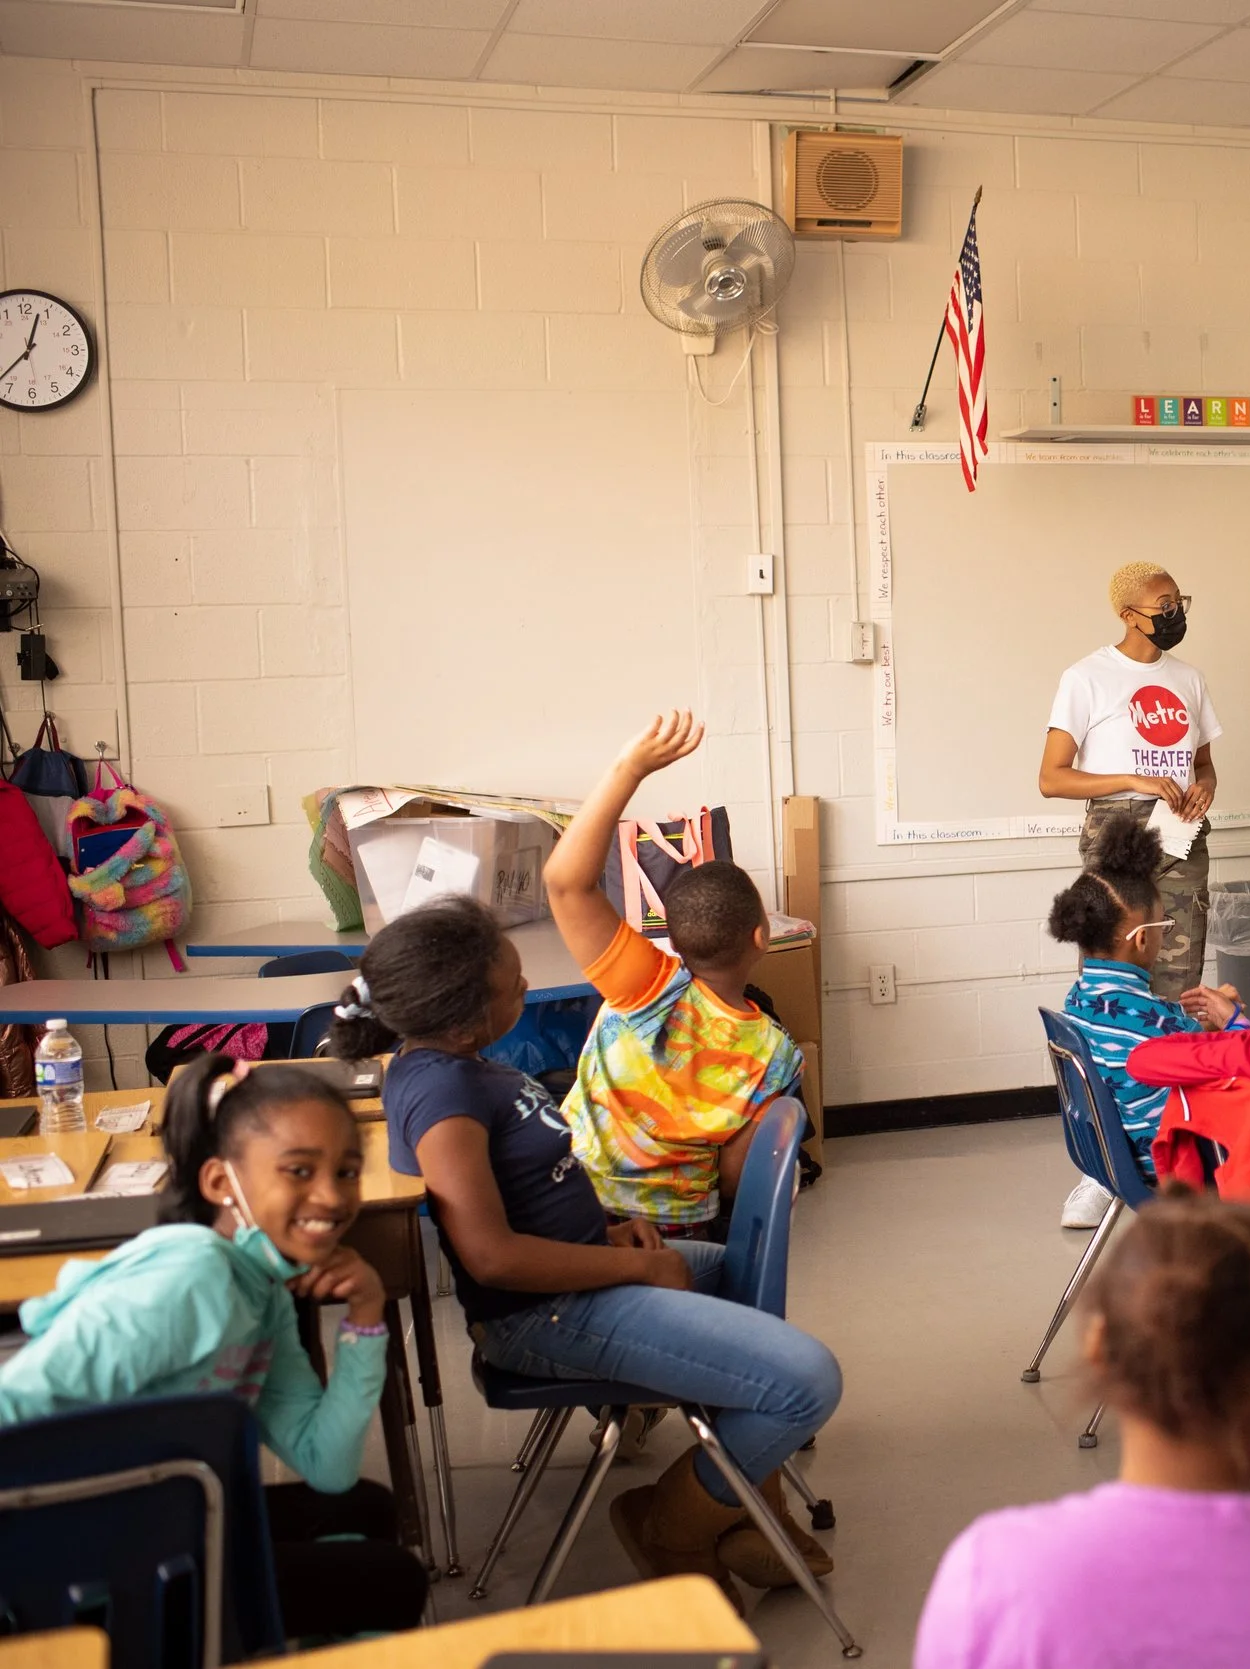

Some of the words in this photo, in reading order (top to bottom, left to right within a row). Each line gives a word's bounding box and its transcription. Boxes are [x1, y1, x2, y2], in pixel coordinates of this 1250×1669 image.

[17, 303, 33, 315] 12
[44, 308, 50, 320] 1
[62, 325, 71, 337] 2
[70, 344, 80, 356] 3
[65, 366, 74, 377] 4
[5, 382, 14, 394] 7
[28, 388, 37, 399] 6
[50, 382, 59, 394] 5
[881, 449, 892, 460] In
[896, 450, 916, 460] this
[919, 450, 961, 460] classroo
[1025, 452, 1037, 461] We
[1149, 448, 1159, 456] We
[876, 511, 887, 536] each
[879, 541, 890, 580] respect
[878, 582, 889, 599] We
[885, 671, 893, 688] our
[883, 690, 894, 709] try
[882, 710, 893, 727] We
[1128, 700, 1189, 729] Metro
[1131, 748, 1193, 767] THEATER
[1135, 767, 1187, 778] COMPAN
[893, 826, 903, 840] In
[908, 826, 928, 839] this
[1028, 823, 1042, 834] We
[1045, 824, 1084, 836] respect
